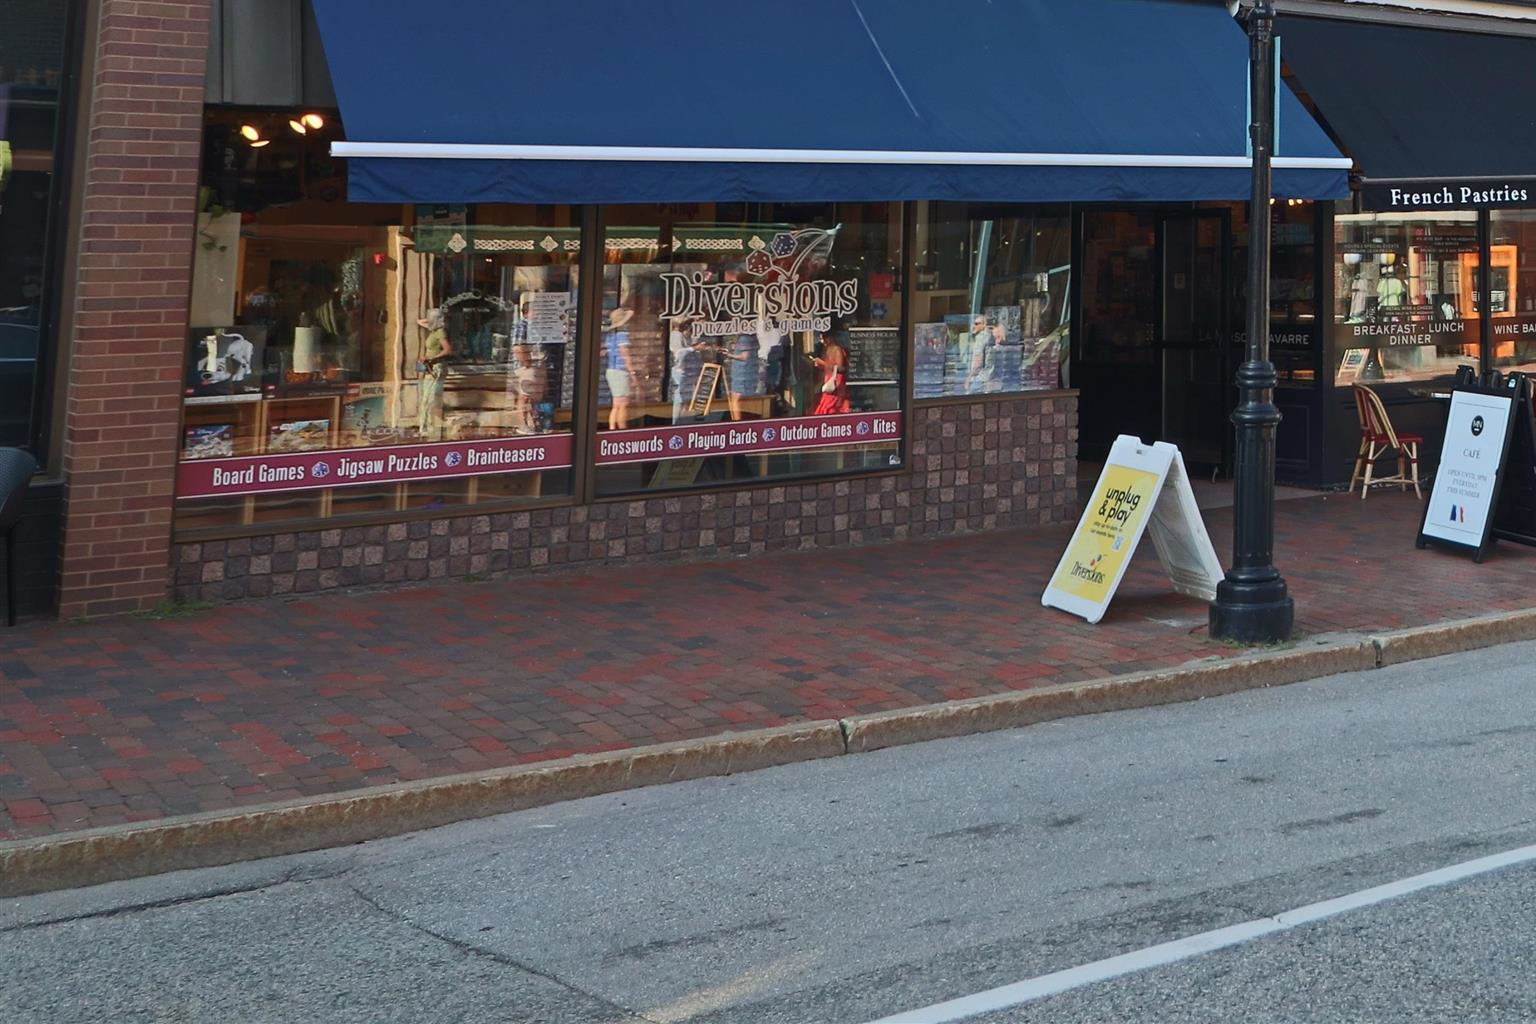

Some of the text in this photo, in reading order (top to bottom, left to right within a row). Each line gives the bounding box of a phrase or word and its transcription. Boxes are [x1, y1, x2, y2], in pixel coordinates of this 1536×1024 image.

[1390, 186, 1455, 207] French
[1459, 184, 1529, 205] Pastries
[659, 271, 859, 321] Diversions
[691, 316, 758, 339] puzzles
[779, 316, 832, 337] games
[1270, 333, 1310, 345] AVARRE
[1353, 322, 1465, 336] BREAKFAST LUNCH
[1494, 324, 1519, 335] WINE
[1389, 334, 1432, 346] DINNER
[600, 419, 897, 456] Crosswords Playing Cards Outdoor Games Kites
[213, 445, 546, 487] Board Games Jigsaw Puzzles Brainteasers
[1105, 486, 1141, 511] unplug
[1098, 500, 1132, 527] & play
[1070, 561, 1106, 585] Diversions
